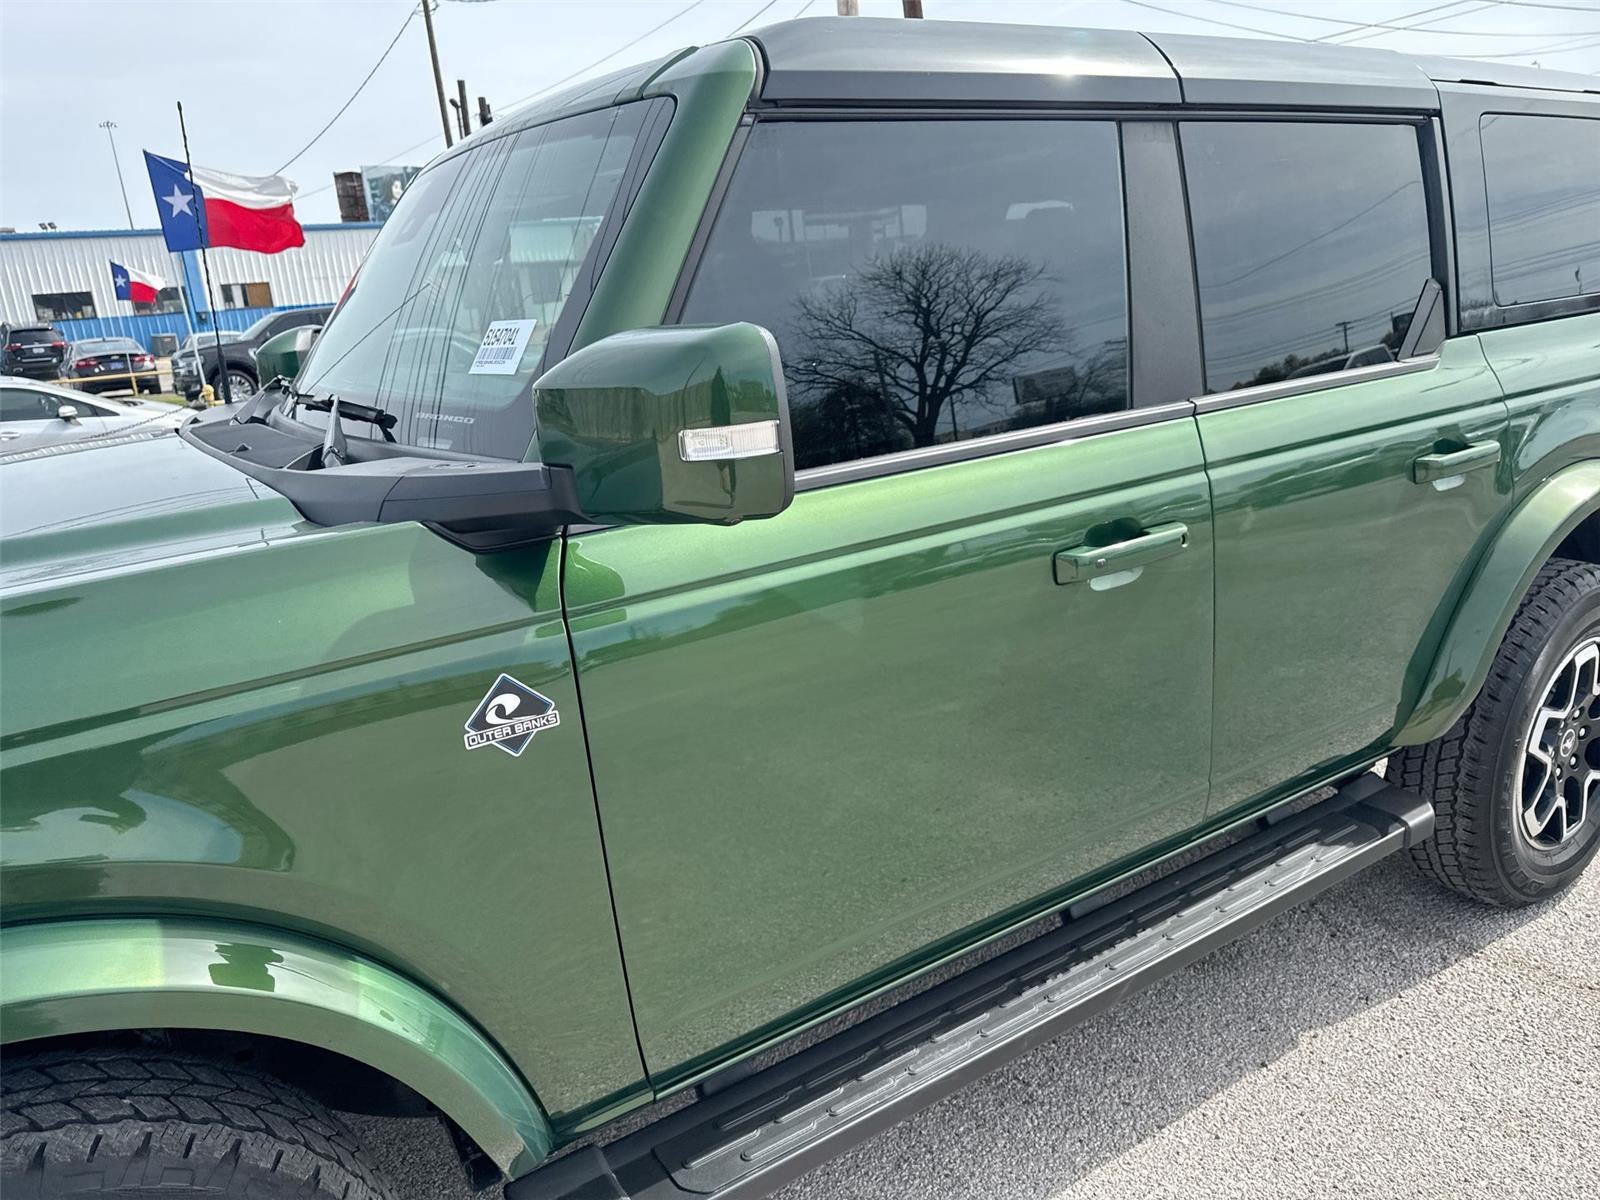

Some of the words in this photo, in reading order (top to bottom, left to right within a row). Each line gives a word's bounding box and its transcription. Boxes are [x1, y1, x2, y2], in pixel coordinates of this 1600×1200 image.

[415, 412, 475, 424] BRONCO
[468, 727, 512, 746] OUTER
[514, 714, 557, 733] BANKS
